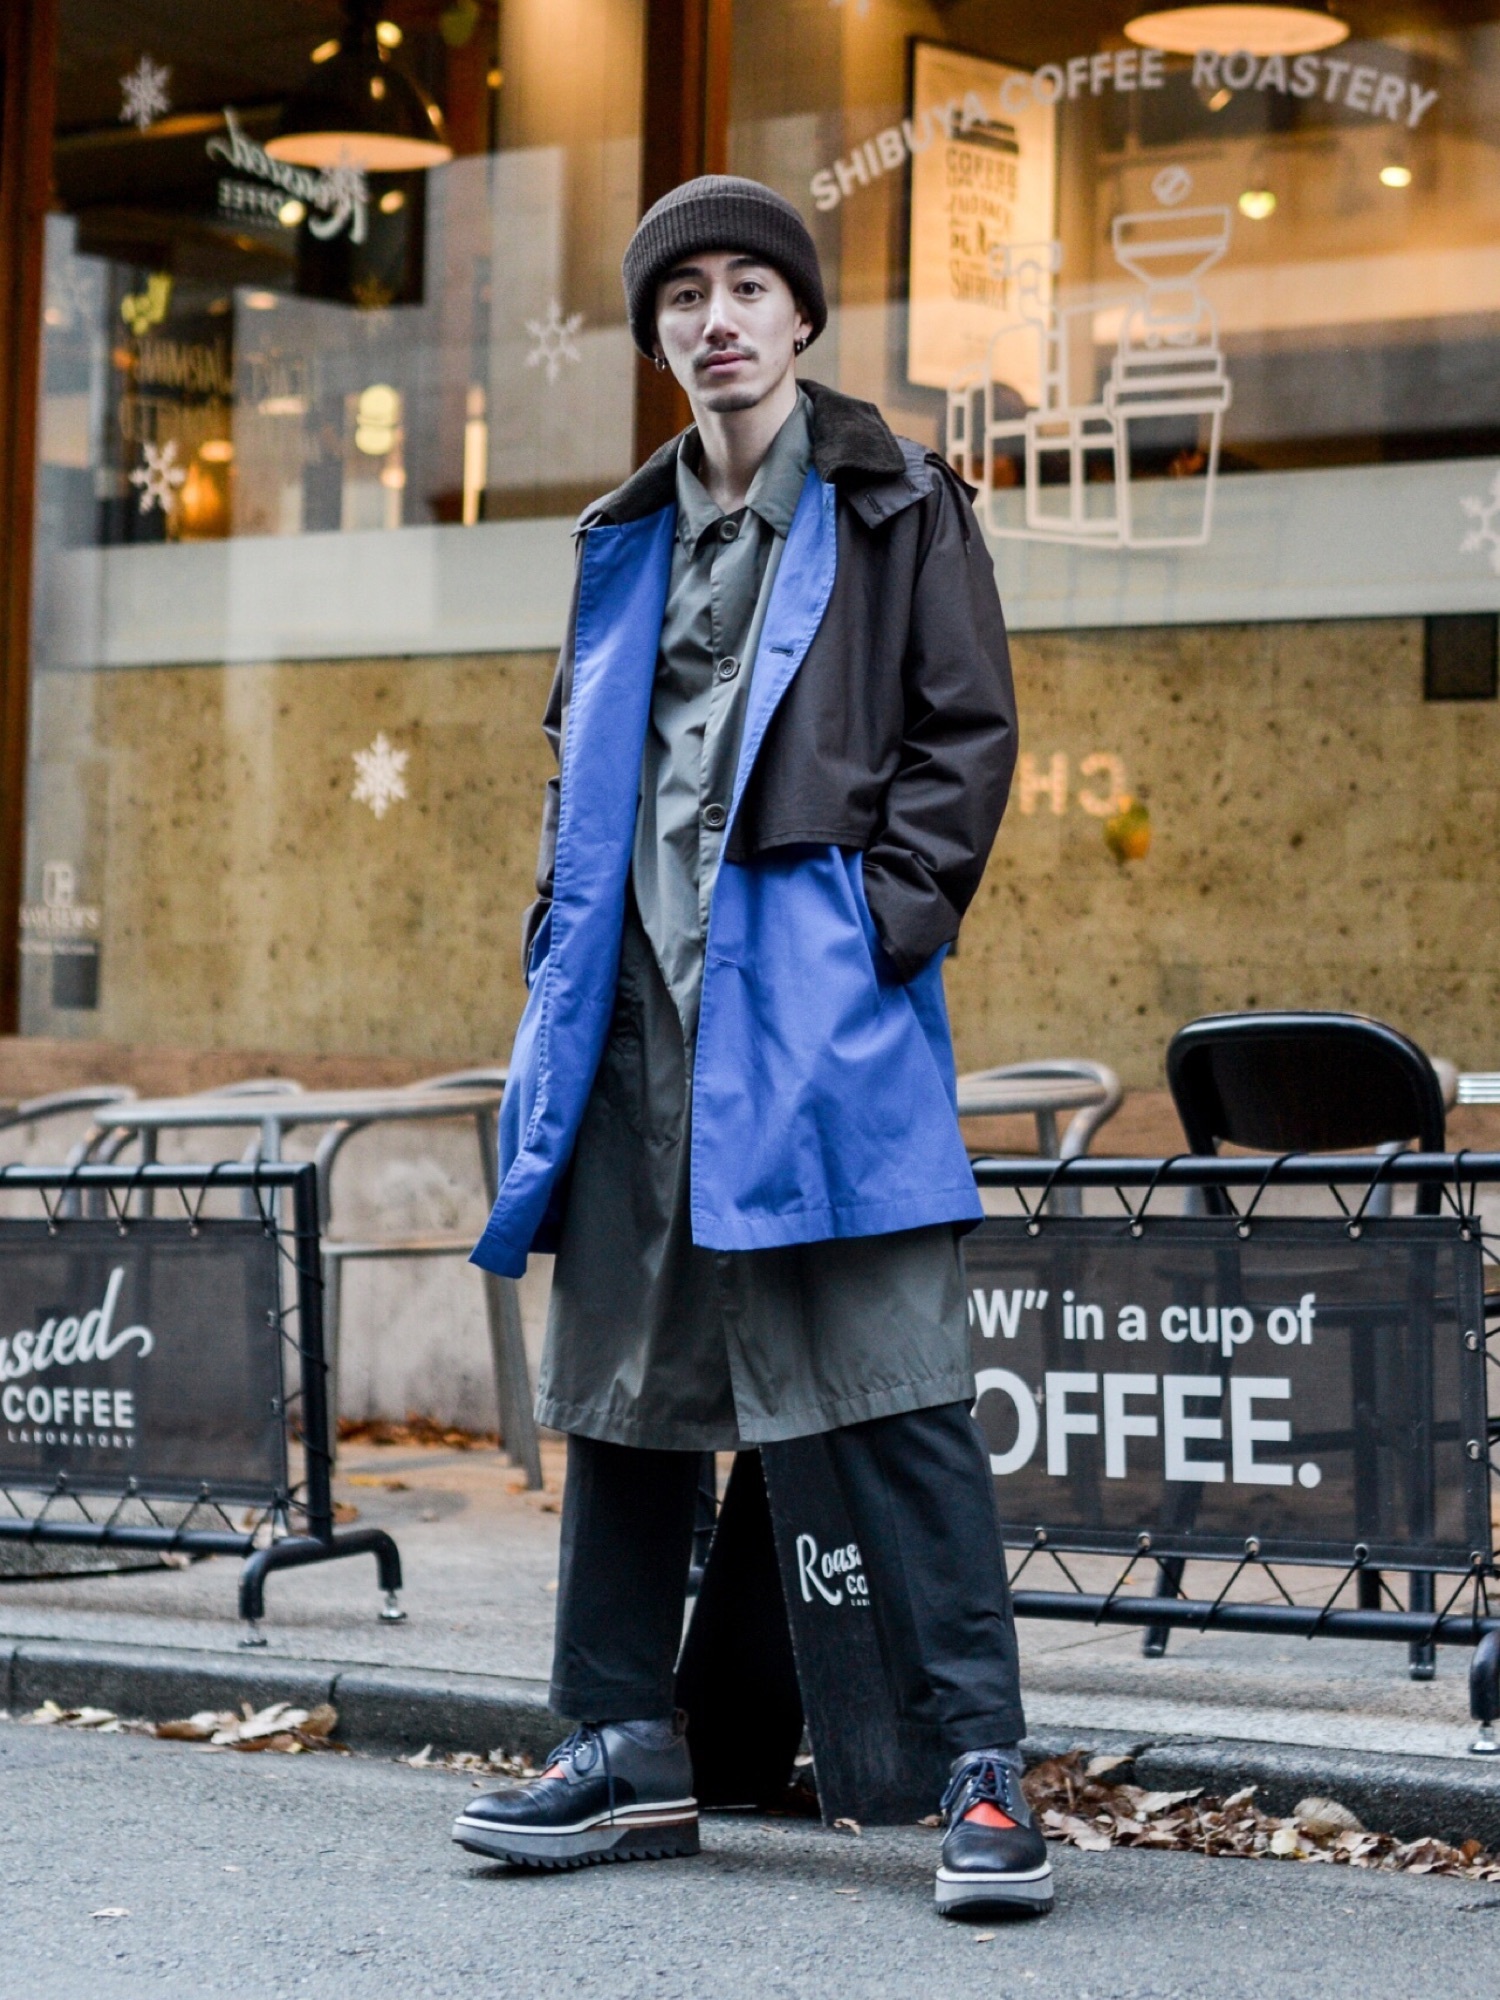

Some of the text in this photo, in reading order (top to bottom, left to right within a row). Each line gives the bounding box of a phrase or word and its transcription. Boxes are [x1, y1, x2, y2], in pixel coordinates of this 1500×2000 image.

[809, 90, 989, 212] SHIBUYA
[999, 48, 1165, 115] COFFEE
[1191, 48, 1438, 128] ROASTERY
[1062, 1289, 1104, 1340] in
[1117, 1304, 1147, 1341] a
[1160, 1307, 1254, 1357] cup
[1266, 1293, 1316, 1345] of
[2, 1384, 135, 1428] COFFEE
